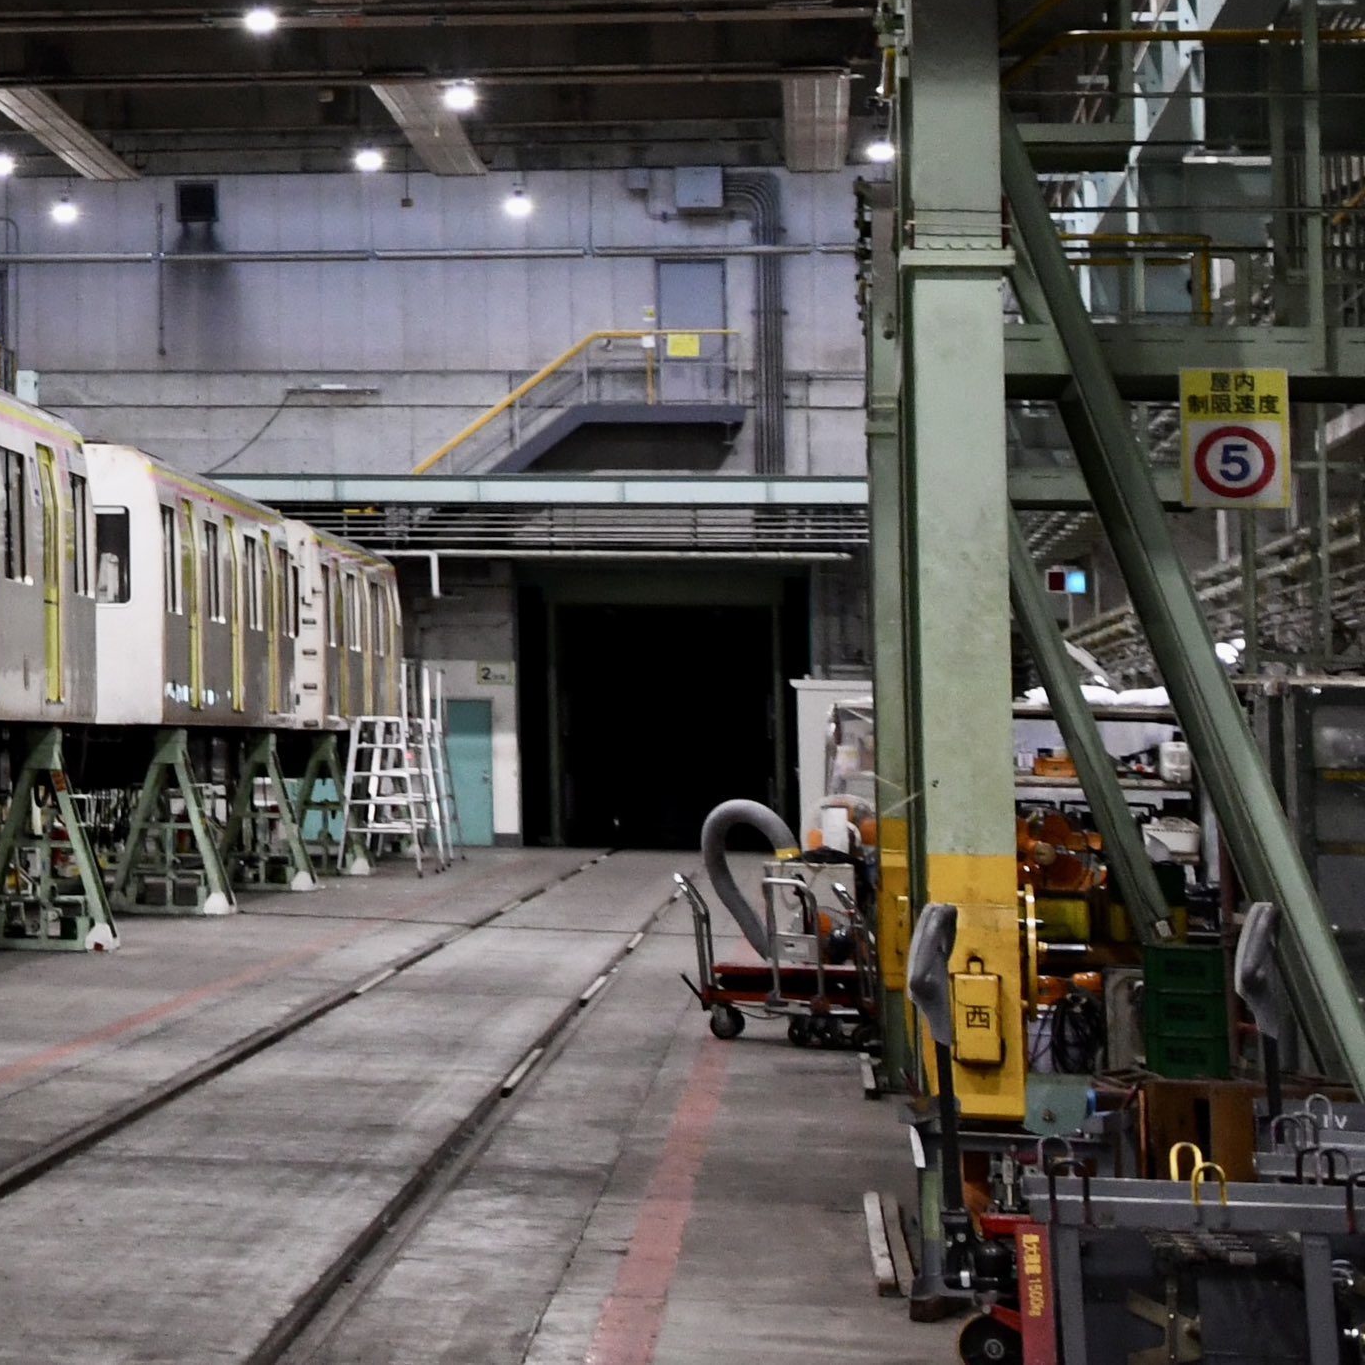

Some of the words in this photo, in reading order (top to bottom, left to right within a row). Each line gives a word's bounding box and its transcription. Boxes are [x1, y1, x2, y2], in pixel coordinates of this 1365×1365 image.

[1187, 394, 1281, 415] 制限速度
[1220, 444, 1251, 482] 5
[966, 1004, 991, 1029] 西
